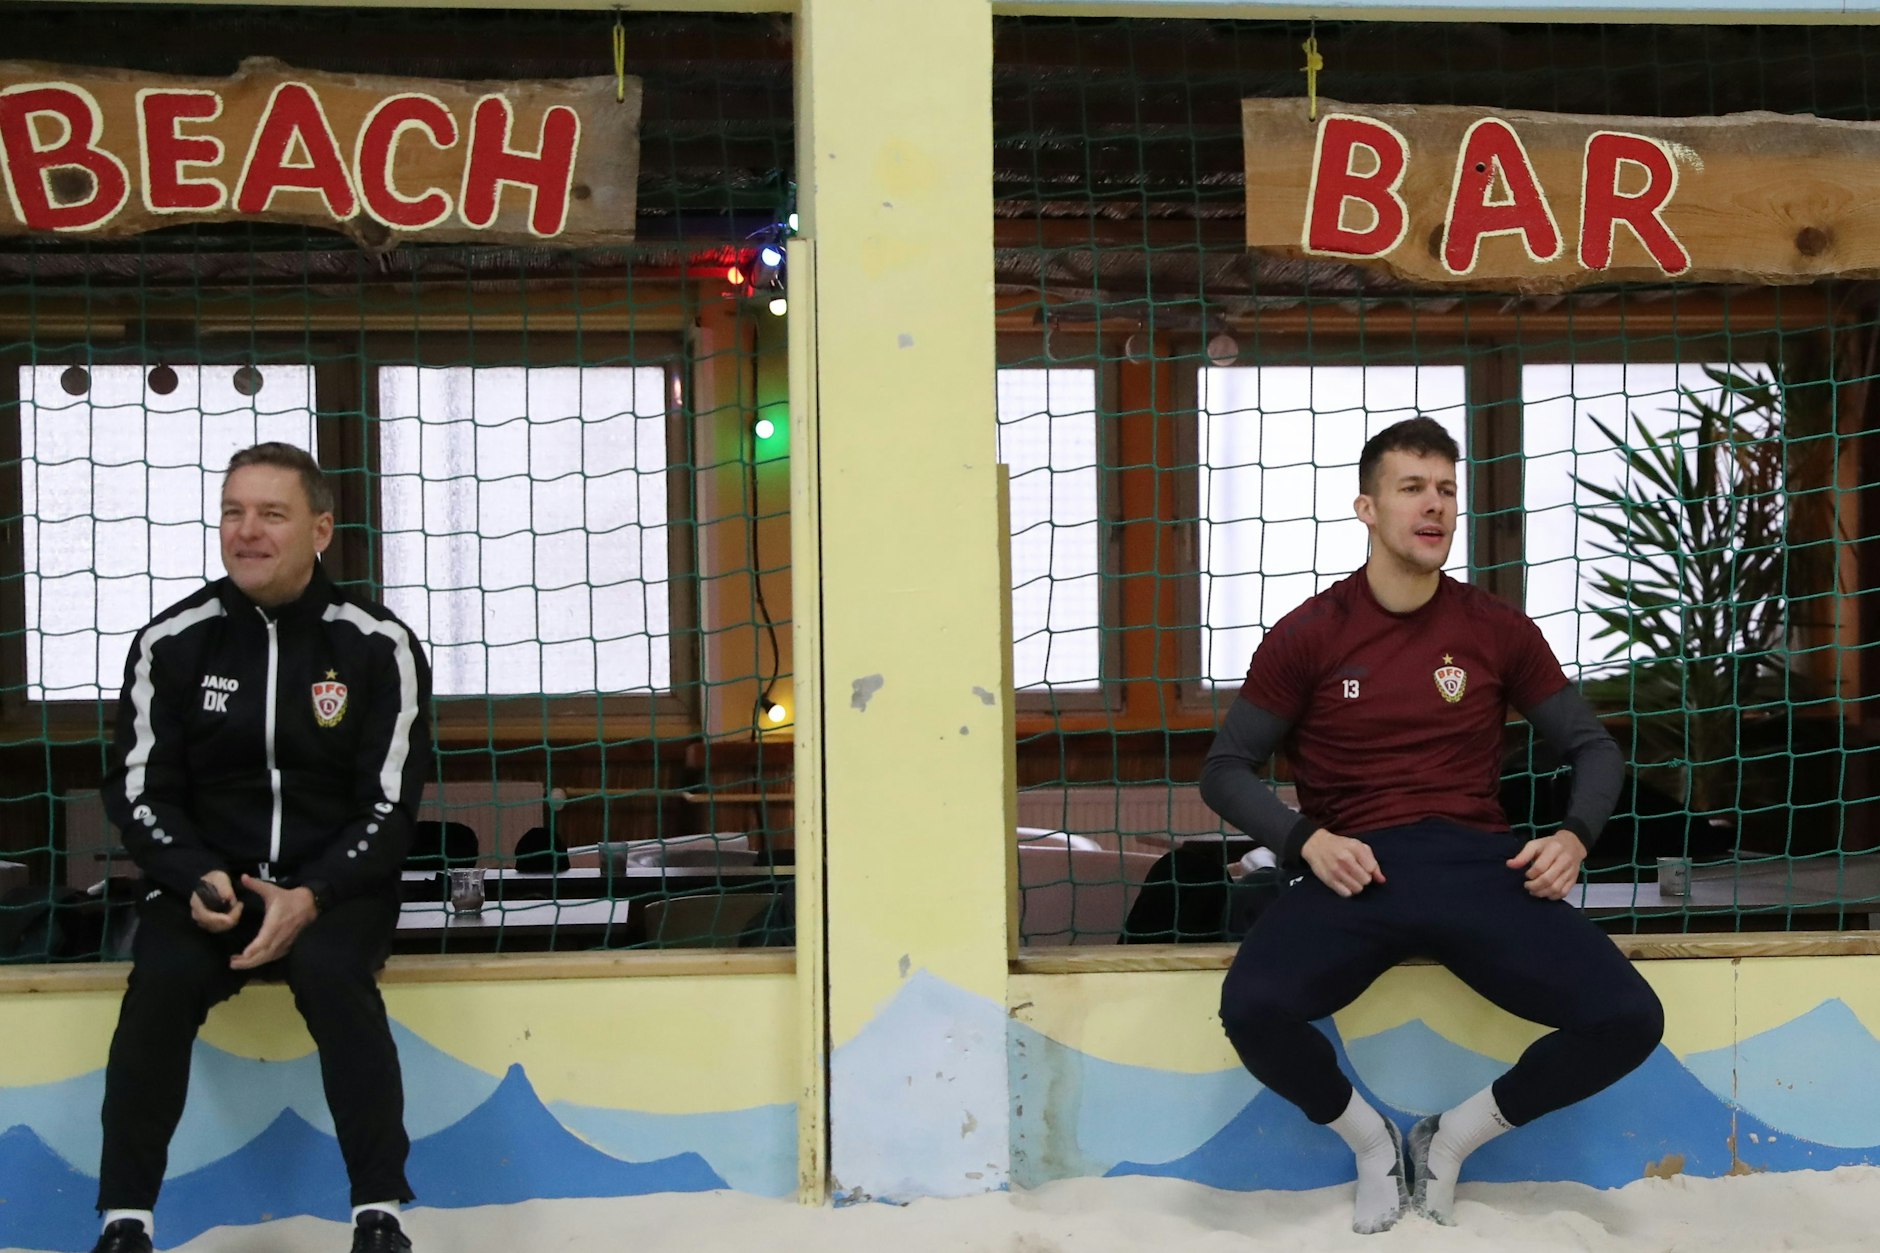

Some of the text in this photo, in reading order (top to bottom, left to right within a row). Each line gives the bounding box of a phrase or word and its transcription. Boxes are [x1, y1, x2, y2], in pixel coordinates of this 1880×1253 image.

[0, 81, 581, 237] BEACH
[1302, 113, 1692, 277] BAR
[201, 675, 240, 692] JAKO
[1437, 668, 1462, 679] BFC
[313, 683, 347, 698] BFC
[1342, 679, 1360, 699] 13
[203, 690, 229, 713] DK
